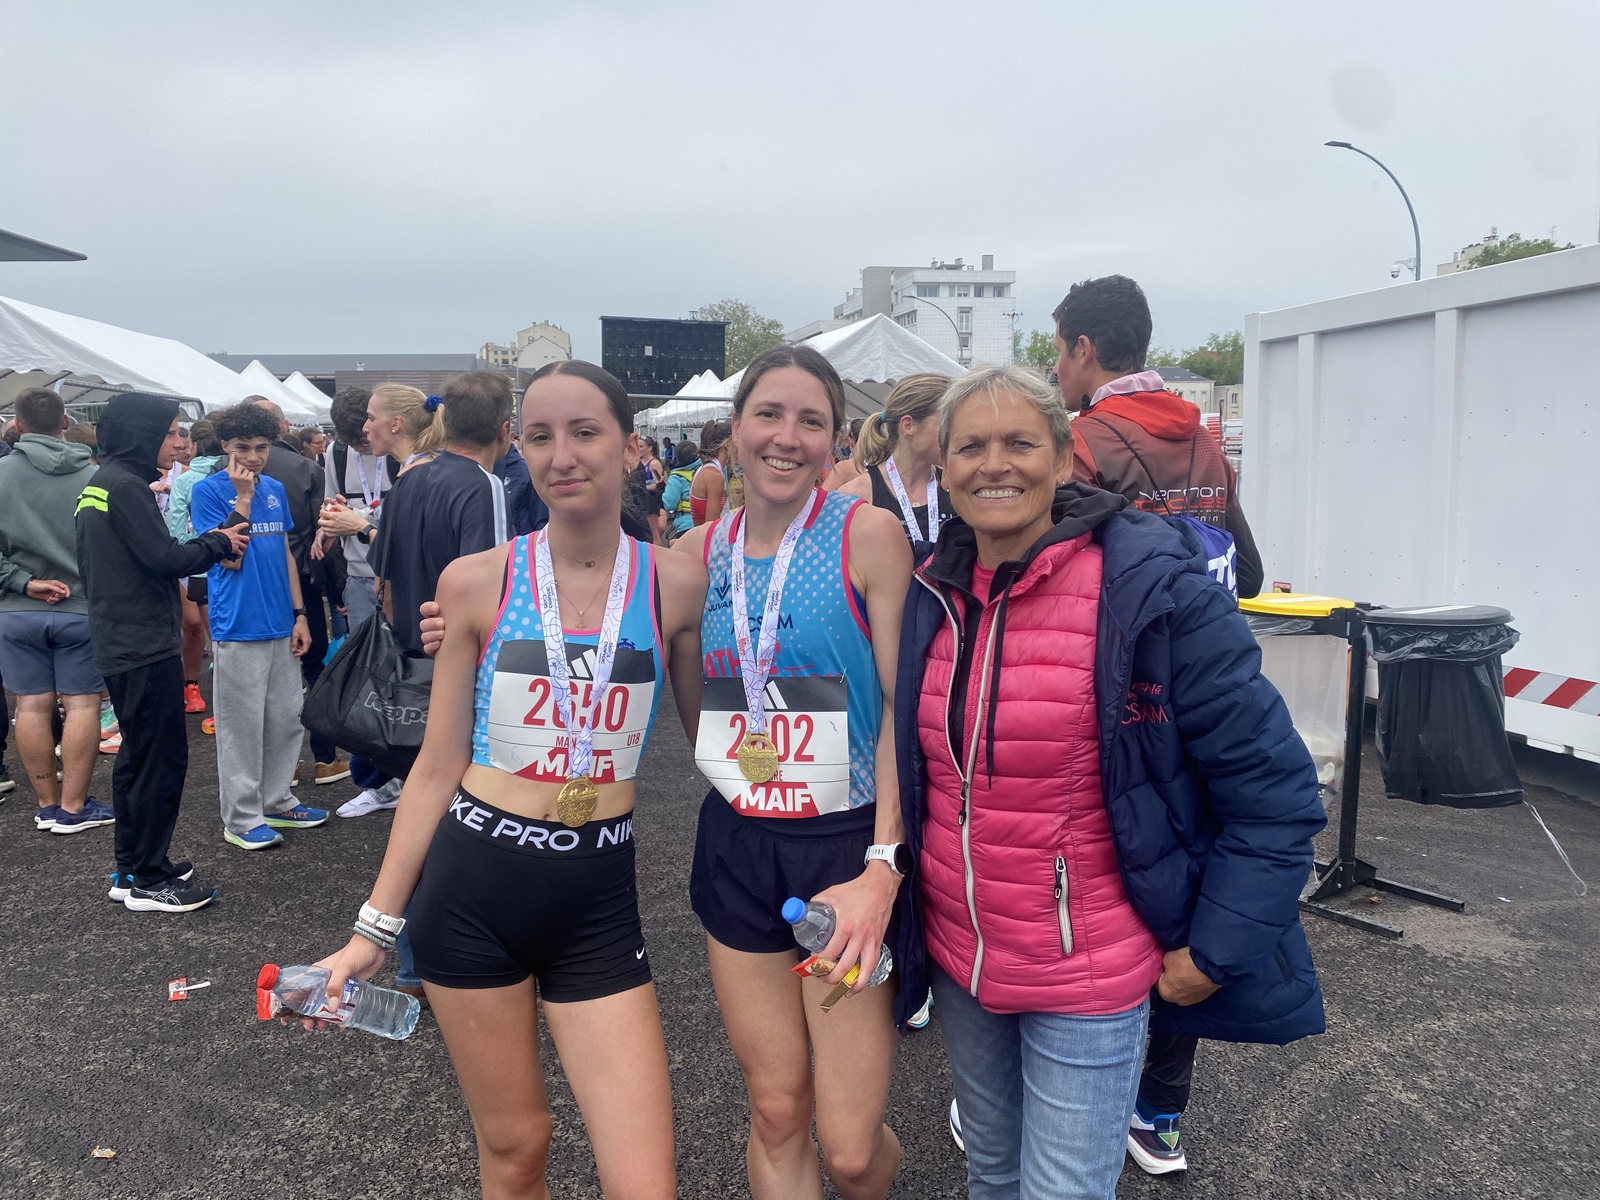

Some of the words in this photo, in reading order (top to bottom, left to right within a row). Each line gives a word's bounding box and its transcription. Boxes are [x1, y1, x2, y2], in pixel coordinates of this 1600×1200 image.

[626, 732, 642, 747] U18
[725, 713, 815, 763] 202
[535, 752, 614, 778] MIF
[739, 786, 811, 812] MAIF
[491, 818, 580, 851] PRO
